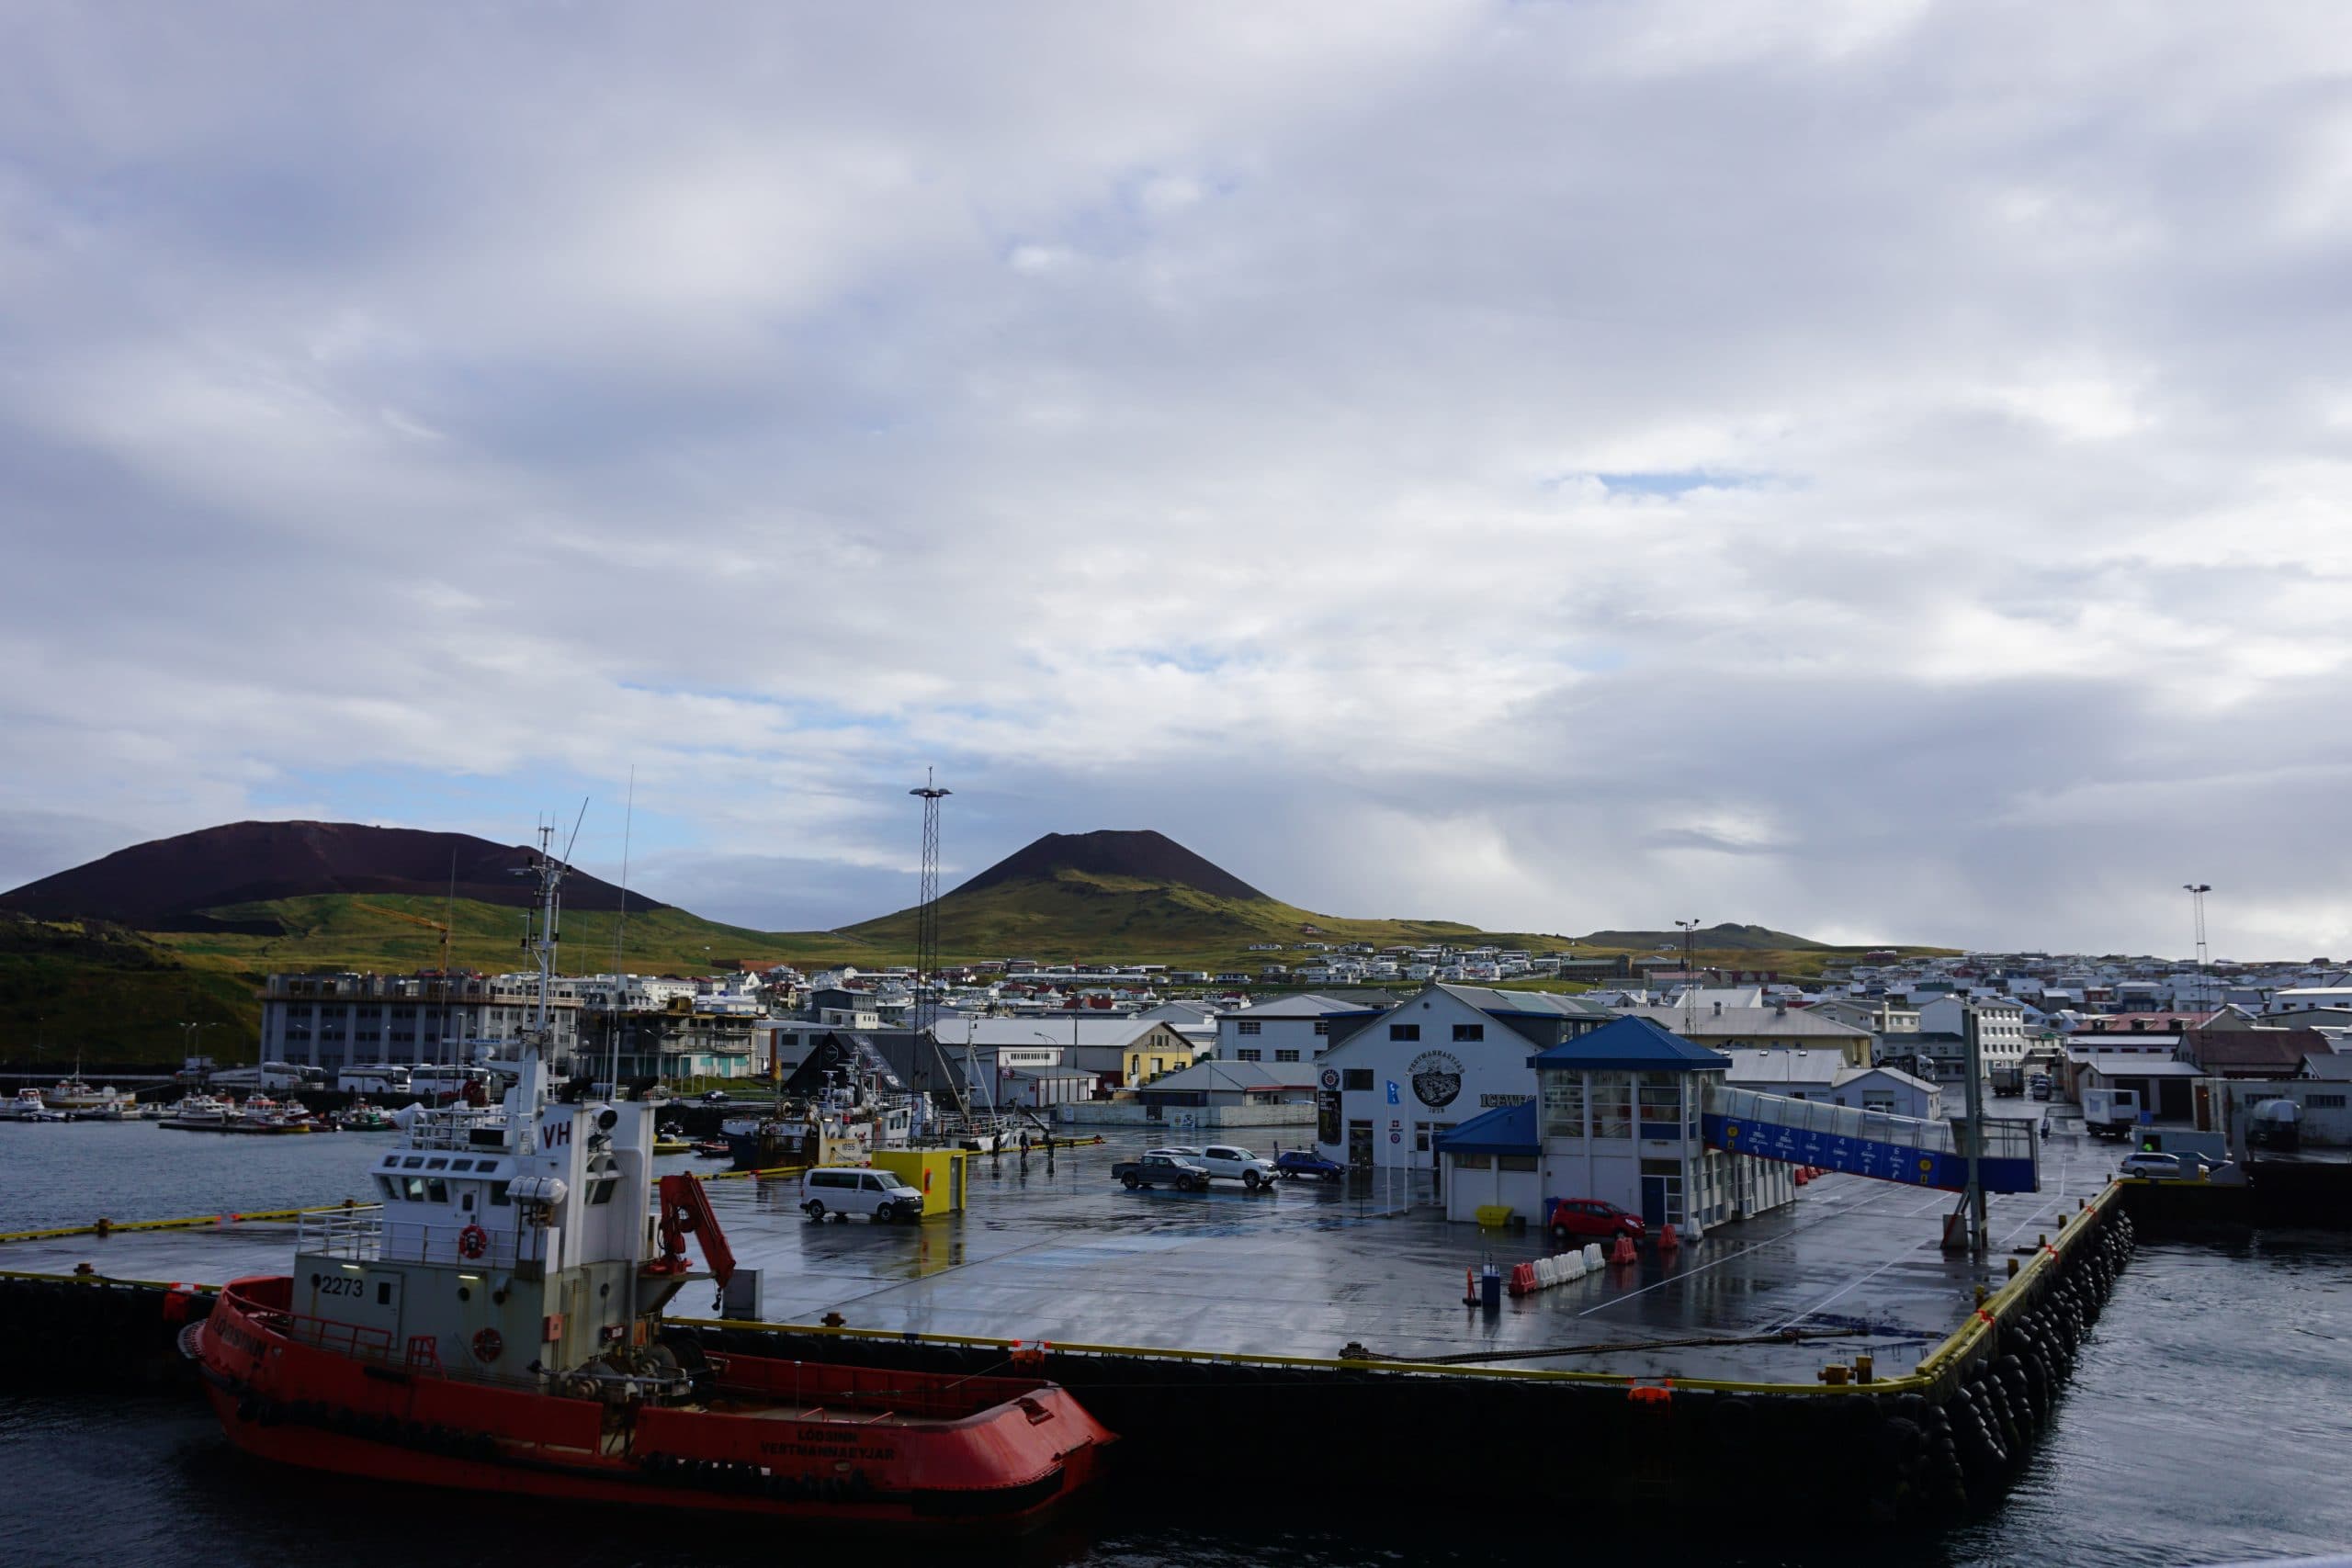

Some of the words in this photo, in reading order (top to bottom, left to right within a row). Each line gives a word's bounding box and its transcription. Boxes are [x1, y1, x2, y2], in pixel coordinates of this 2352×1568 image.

[1480, 1093, 1537, 1108] ICEWE
[543, 1121, 571, 1148] VH
[1812, 1133, 1817, 1141] 3
[322, 1276, 363, 1297] 2273
